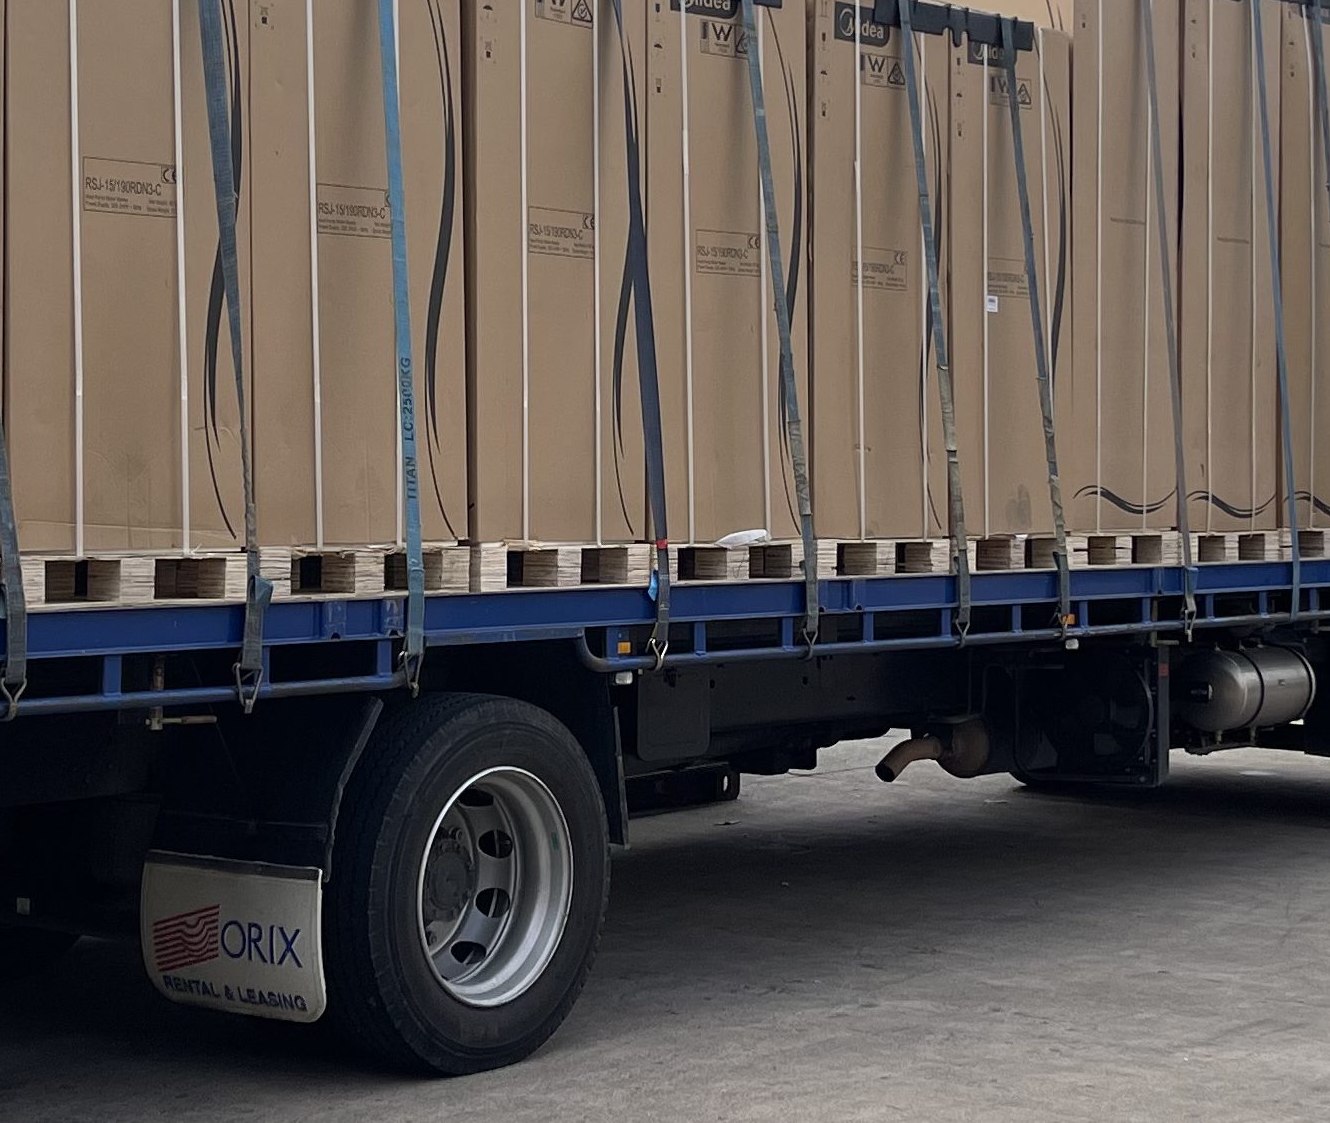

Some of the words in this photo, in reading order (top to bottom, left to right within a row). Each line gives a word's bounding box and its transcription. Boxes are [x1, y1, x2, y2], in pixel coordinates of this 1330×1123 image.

[407, 456, 417, 499] TITAN
[221, 920, 303, 968] ORIX
[164, 975, 221, 999] RENTAL
[224, 985, 236, 1001] &
[237, 986, 308, 1012] LEASING
